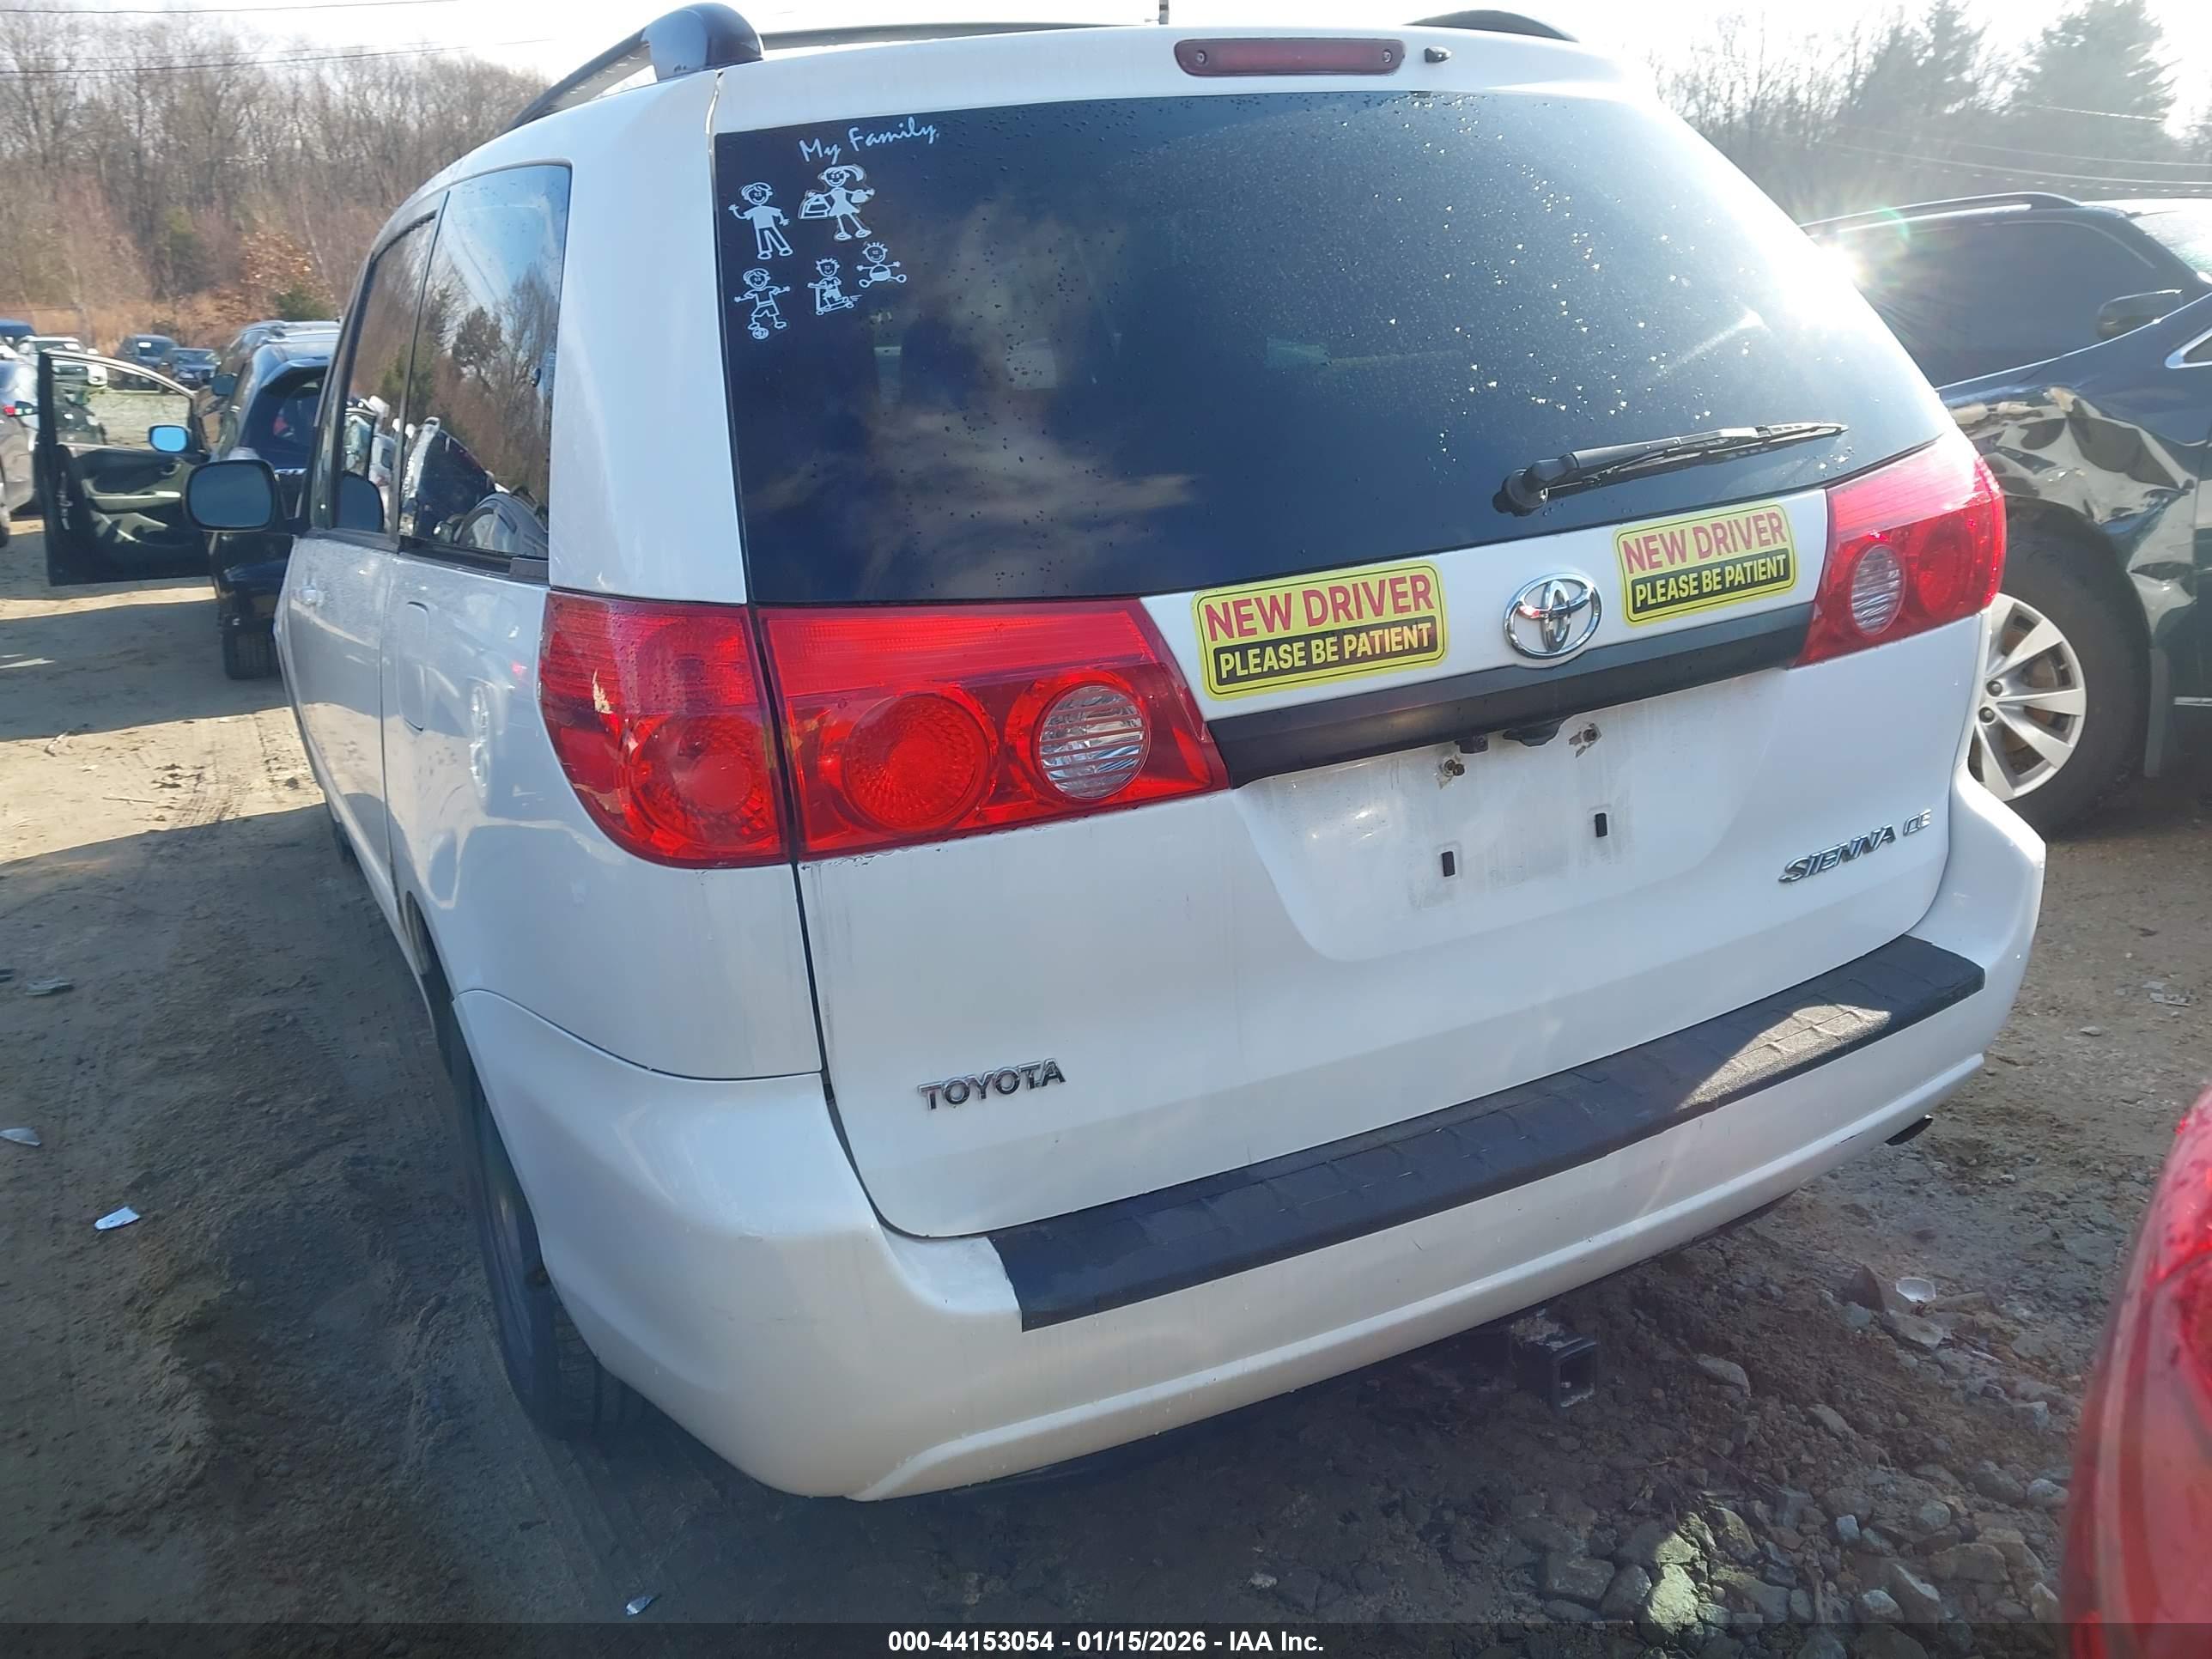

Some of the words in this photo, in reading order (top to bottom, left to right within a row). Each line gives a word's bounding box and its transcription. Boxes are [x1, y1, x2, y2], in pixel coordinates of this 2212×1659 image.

[799, 138, 841, 164] My
[848, 117, 937, 150] Family
[1622, 529, 1687, 574] NEW
[1692, 512, 1787, 559] DRIVER
[1205, 592, 1291, 641] NEW
[1303, 574, 1434, 626] DRIVER
[1635, 575, 1699, 608] PLEASE
[1701, 568, 1723, 592] BE
[1724, 554, 1787, 587] PATIENT
[1219, 641, 1307, 678] PLEASE
[1310, 635, 1340, 665] BE
[1343, 622, 1432, 659] PATIENT
[1778, 823, 1896, 883] SIENNA
[918, 1058, 1066, 1111] TOYOTA
